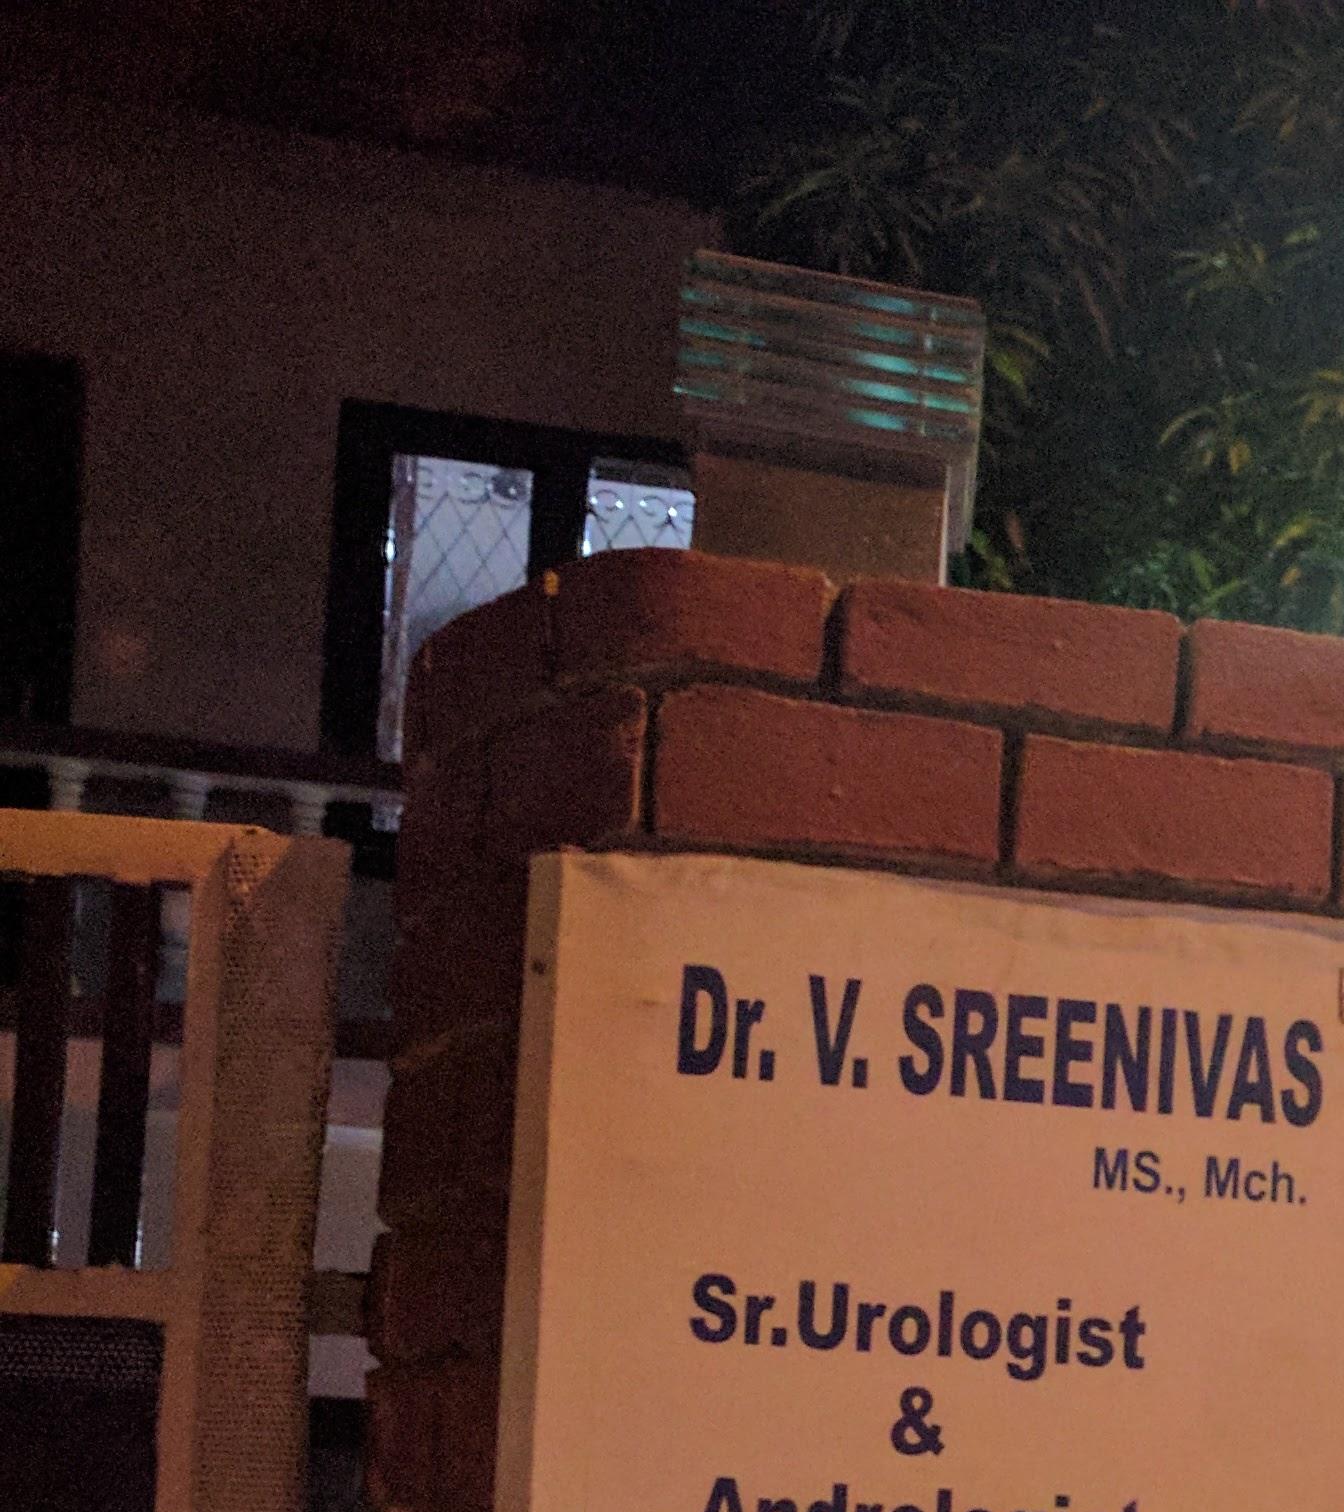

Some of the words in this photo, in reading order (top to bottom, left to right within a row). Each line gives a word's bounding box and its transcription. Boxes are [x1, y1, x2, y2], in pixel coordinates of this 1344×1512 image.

[676, 963, 775, 1081] Dr.
[808, 973, 869, 1090] V.
[898, 983, 1323, 1128] SREENIVAS
[1093, 1147, 1186, 1203] MS.,
[1204, 1155, 1308, 1206] Mch.
[688, 1272, 1146, 1381] Sr.Urologist
[890, 1386, 945, 1456] &
